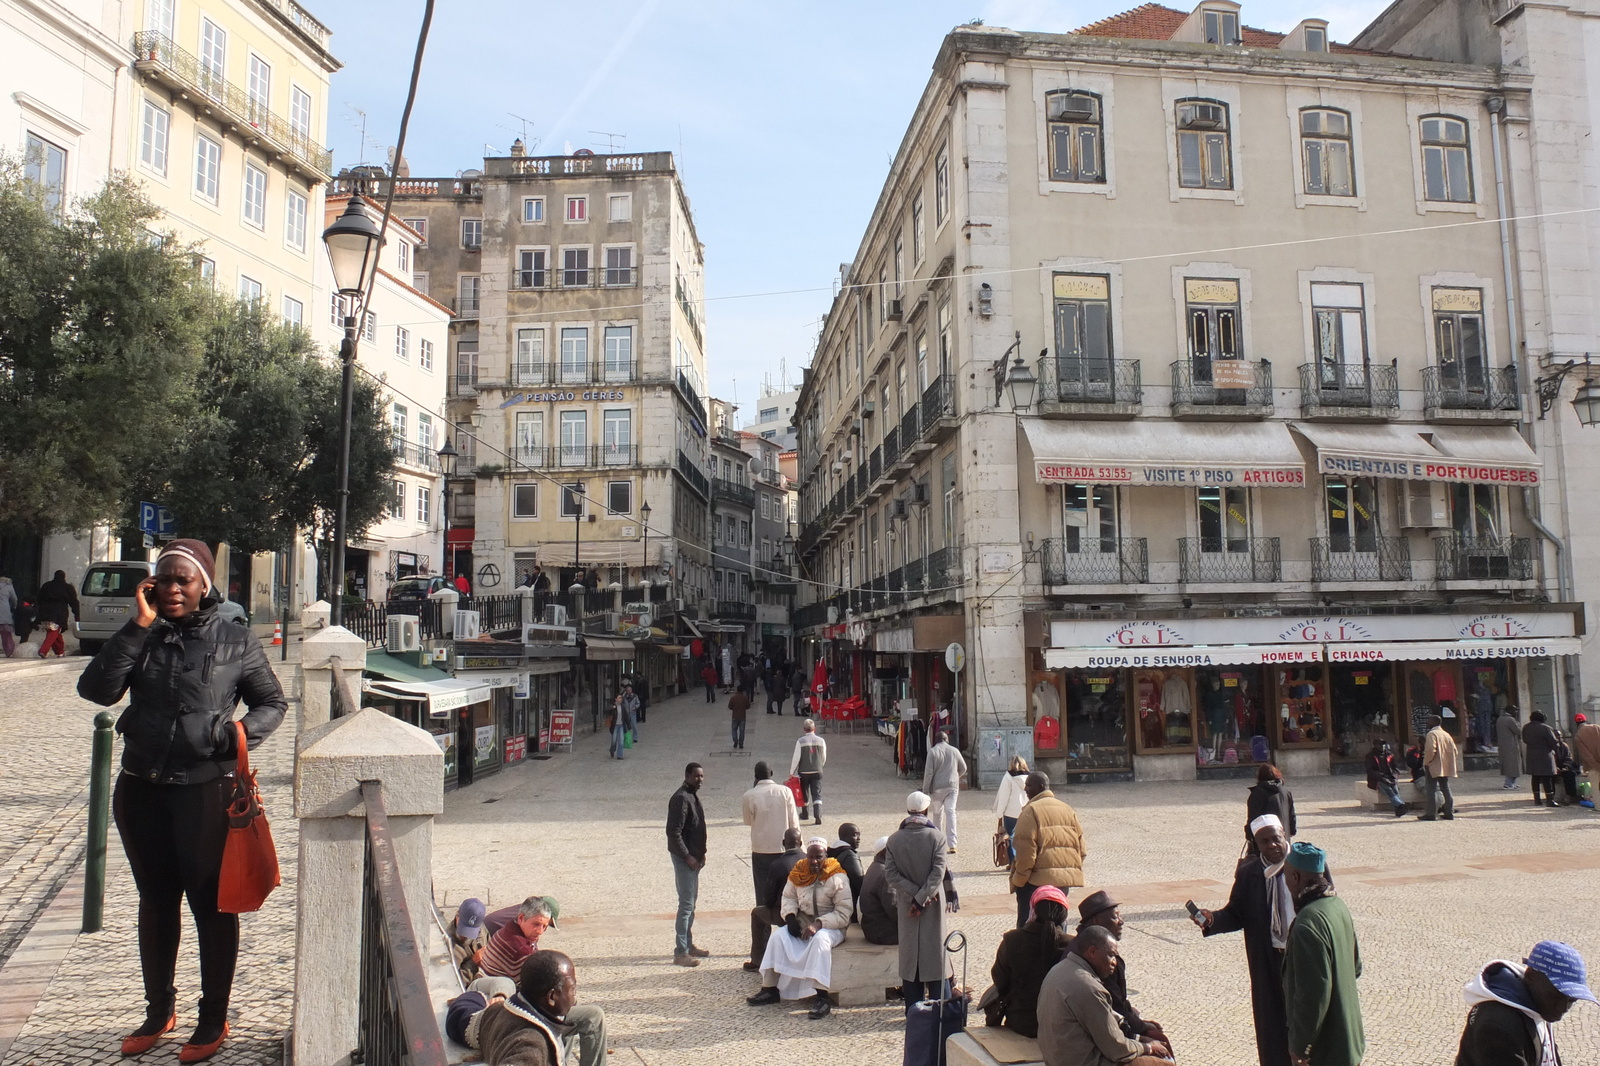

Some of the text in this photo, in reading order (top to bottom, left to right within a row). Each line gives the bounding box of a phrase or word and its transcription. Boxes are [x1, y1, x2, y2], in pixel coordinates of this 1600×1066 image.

[526, 390, 575, 402] PENSÃO
[1045, 466, 1095, 478] ENTRADA
[1143, 468, 1186, 482] VISITE
[1204, 470, 1234, 483] PISO
[1243, 470, 1304, 484] ARTIGOS
[1324, 457, 1538, 483] ORIENTAIS E PORTUGUESES
[143, 505, 155, 528] P
[1117, 629, 1171, 645] G & L
[1302, 626, 1352, 641] G & L
[1470, 622, 1518, 637] G & L
[1261, 650, 1384, 661] HOMEM E CRIANÇA
[1446, 646, 1546, 657] MALAS E SAPATOS
[1088, 655, 1212, 666] ROUPA DE SENHORA
